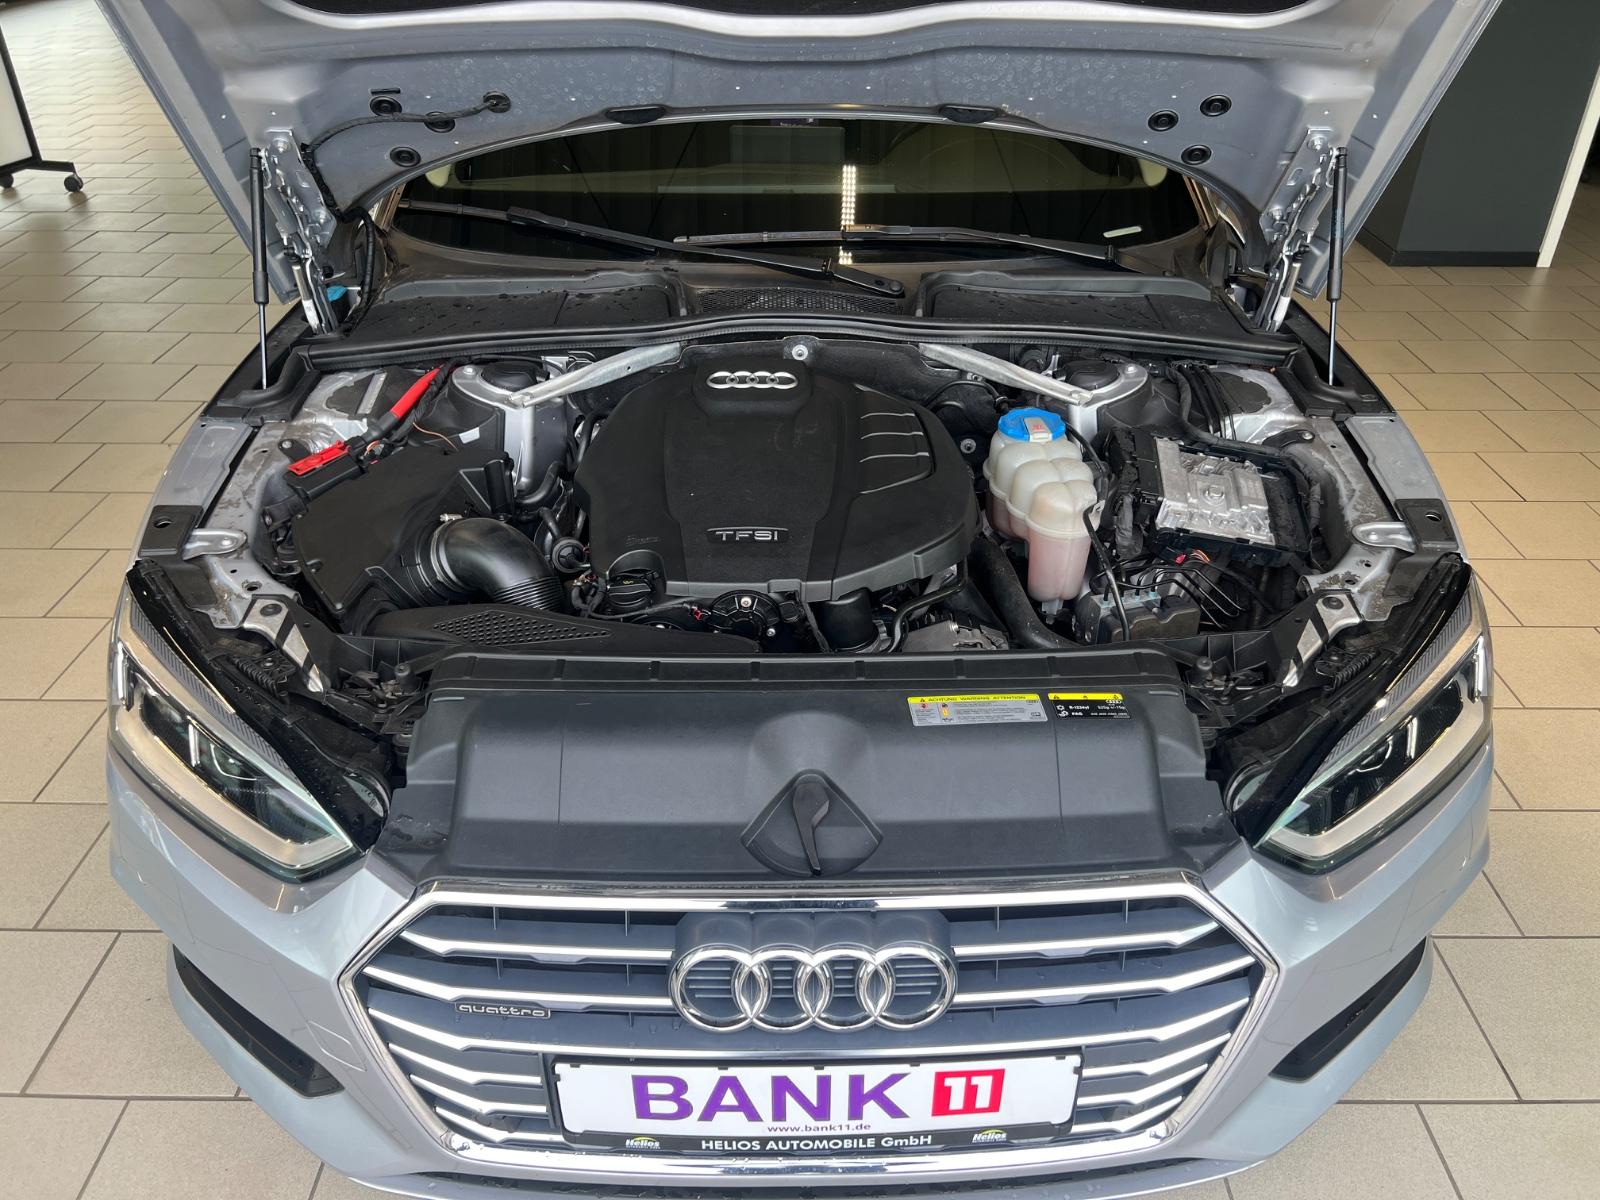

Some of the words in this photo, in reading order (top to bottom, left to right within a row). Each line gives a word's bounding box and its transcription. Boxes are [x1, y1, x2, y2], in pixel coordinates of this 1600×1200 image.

[715, 530, 778, 541] TFSI
[459, 1004, 545, 1017] quattro
[631, 1072, 912, 1122] BANK
[942, 1074, 994, 1111] 11
[767, 1123, 871, 1132] www.bank11.de
[972, 1132, 1007, 1141] Helios
[625, 1138, 660, 1147] Helios
[701, 1140, 760, 1150] HELIOS
[766, 1138, 876, 1150] AUTOMOBILE
[881, 1135, 932, 1147] GmbH
